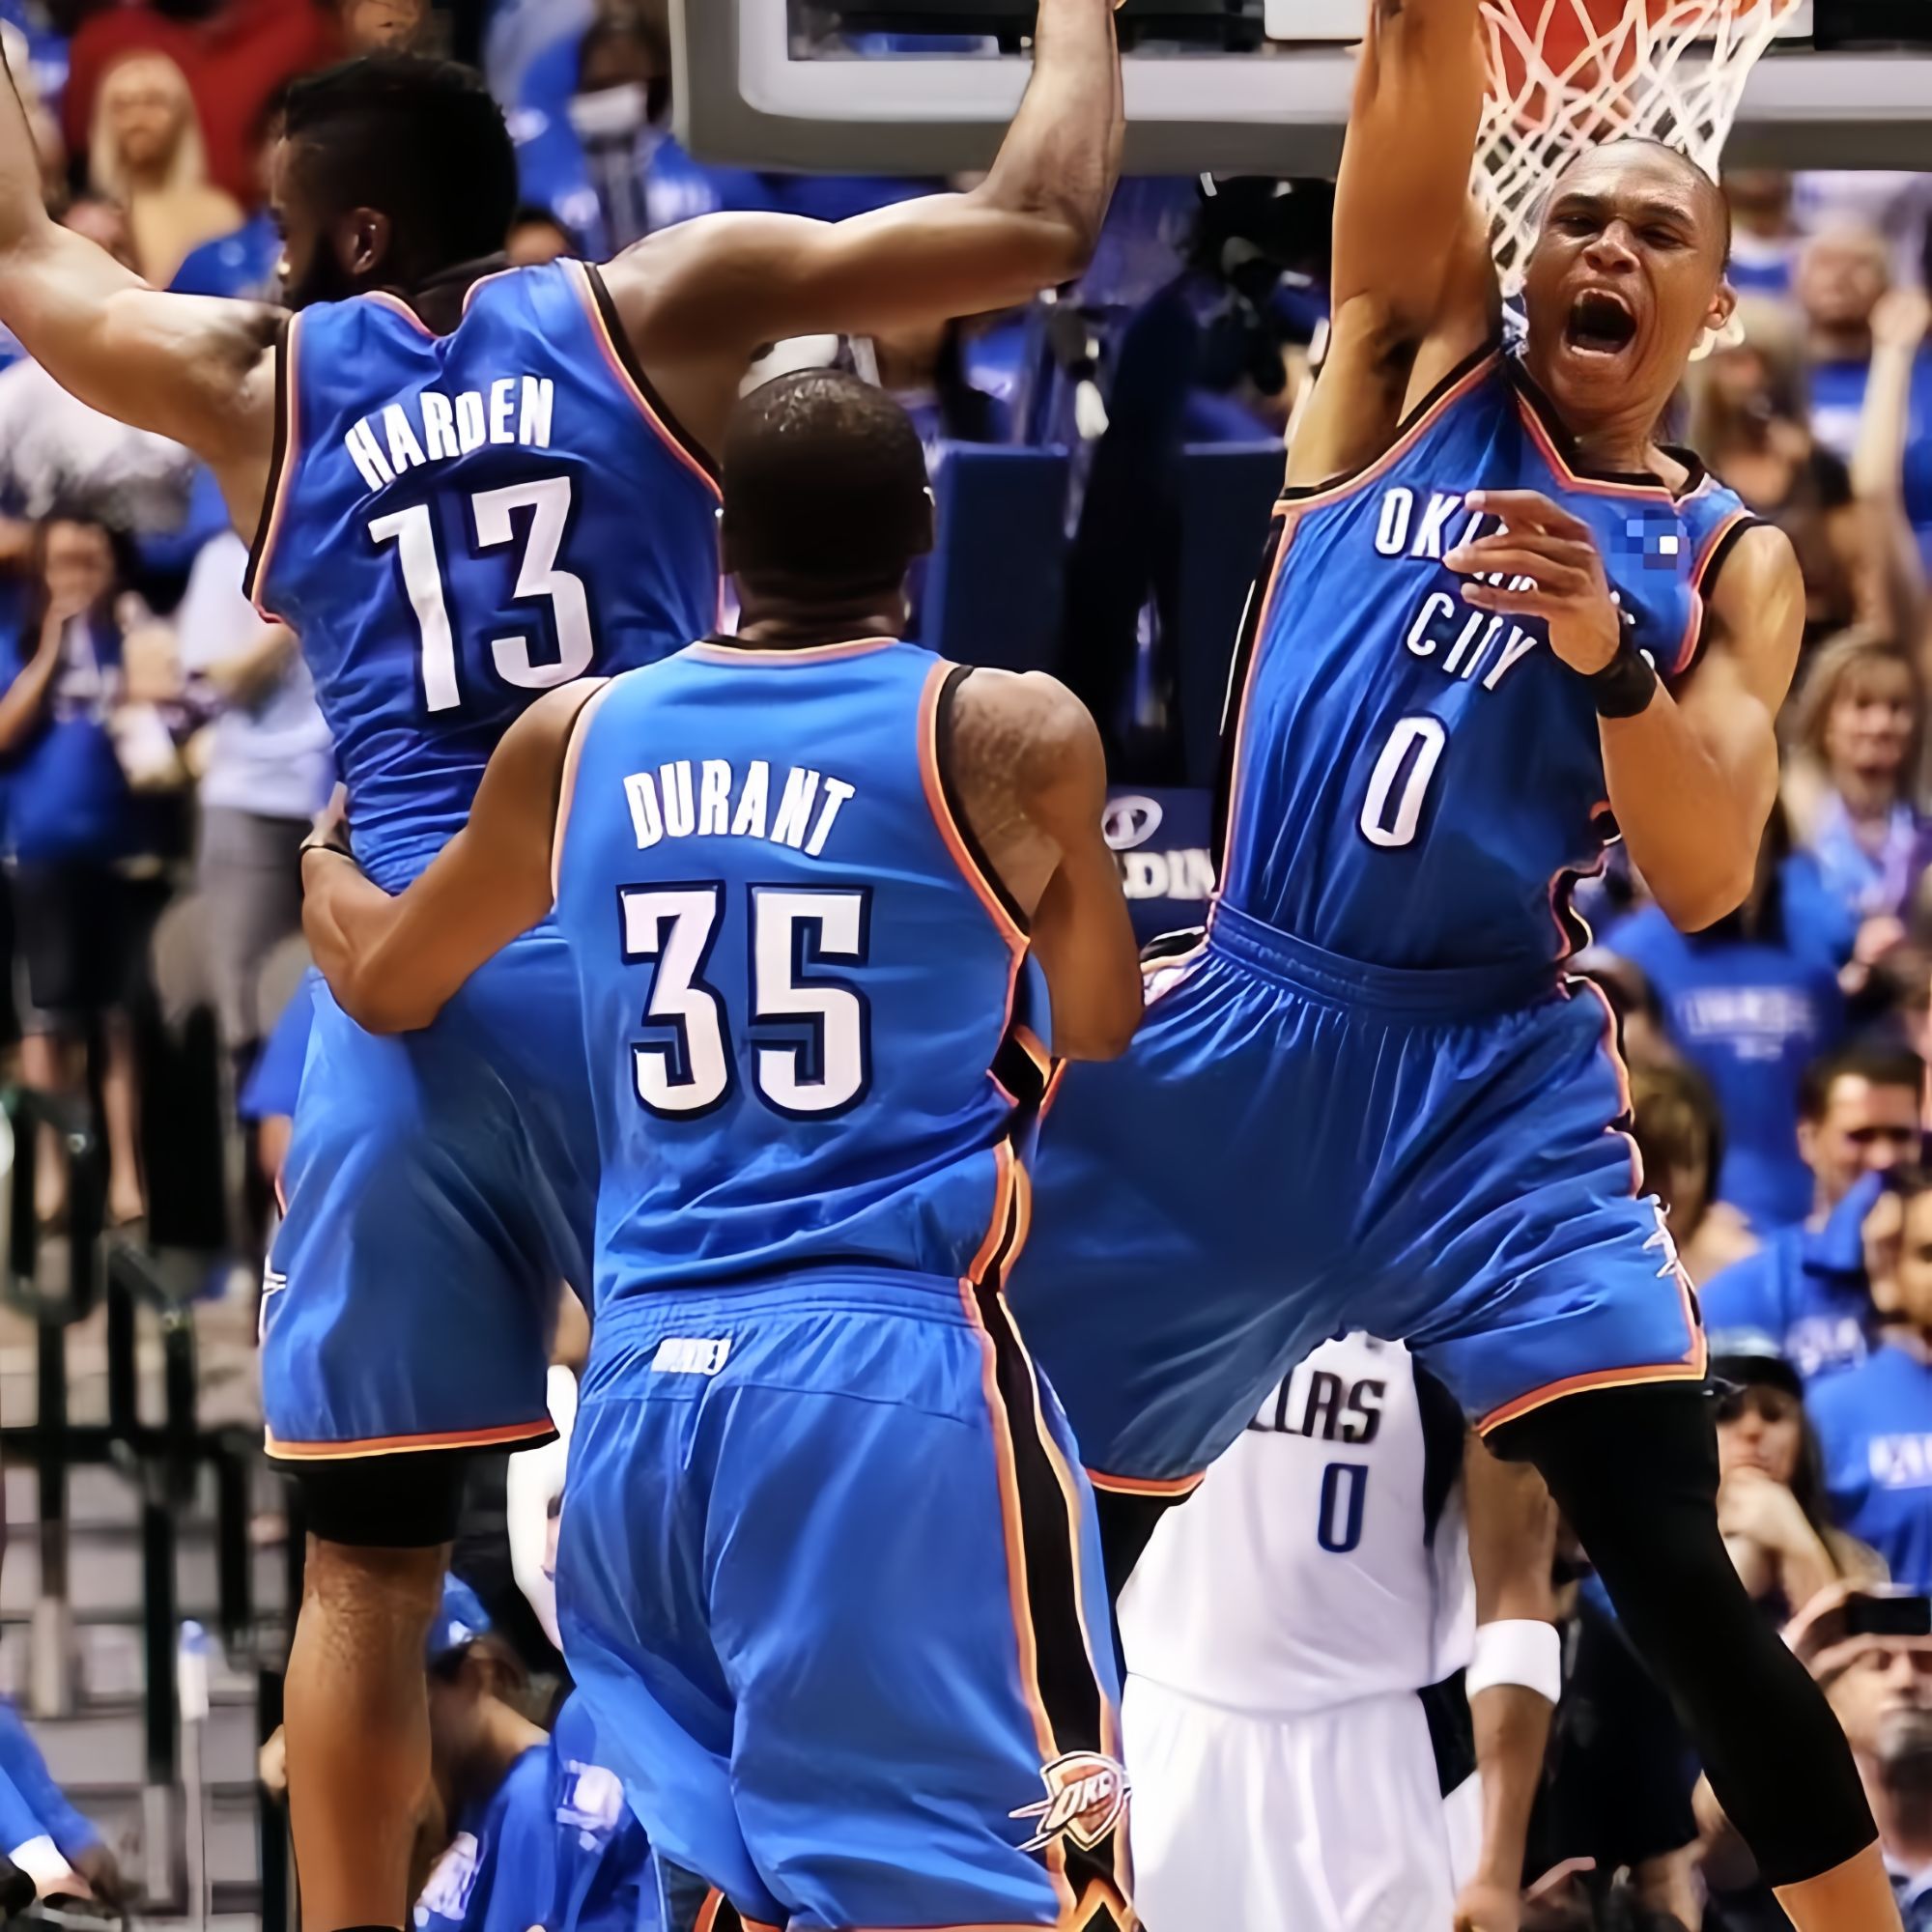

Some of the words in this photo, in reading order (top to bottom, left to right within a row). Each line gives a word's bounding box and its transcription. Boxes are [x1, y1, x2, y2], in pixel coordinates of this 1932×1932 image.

[344, 376, 554, 492] HARDEN
[367, 475, 594, 712] 13
[623, 758, 856, 857] DURANT
[1359, 716, 1446, 847] 0
[618, 883, 869, 1118] 35
[1247, 1369, 1387, 1444] LAS
[1317, 1462, 1369, 1553] 0
